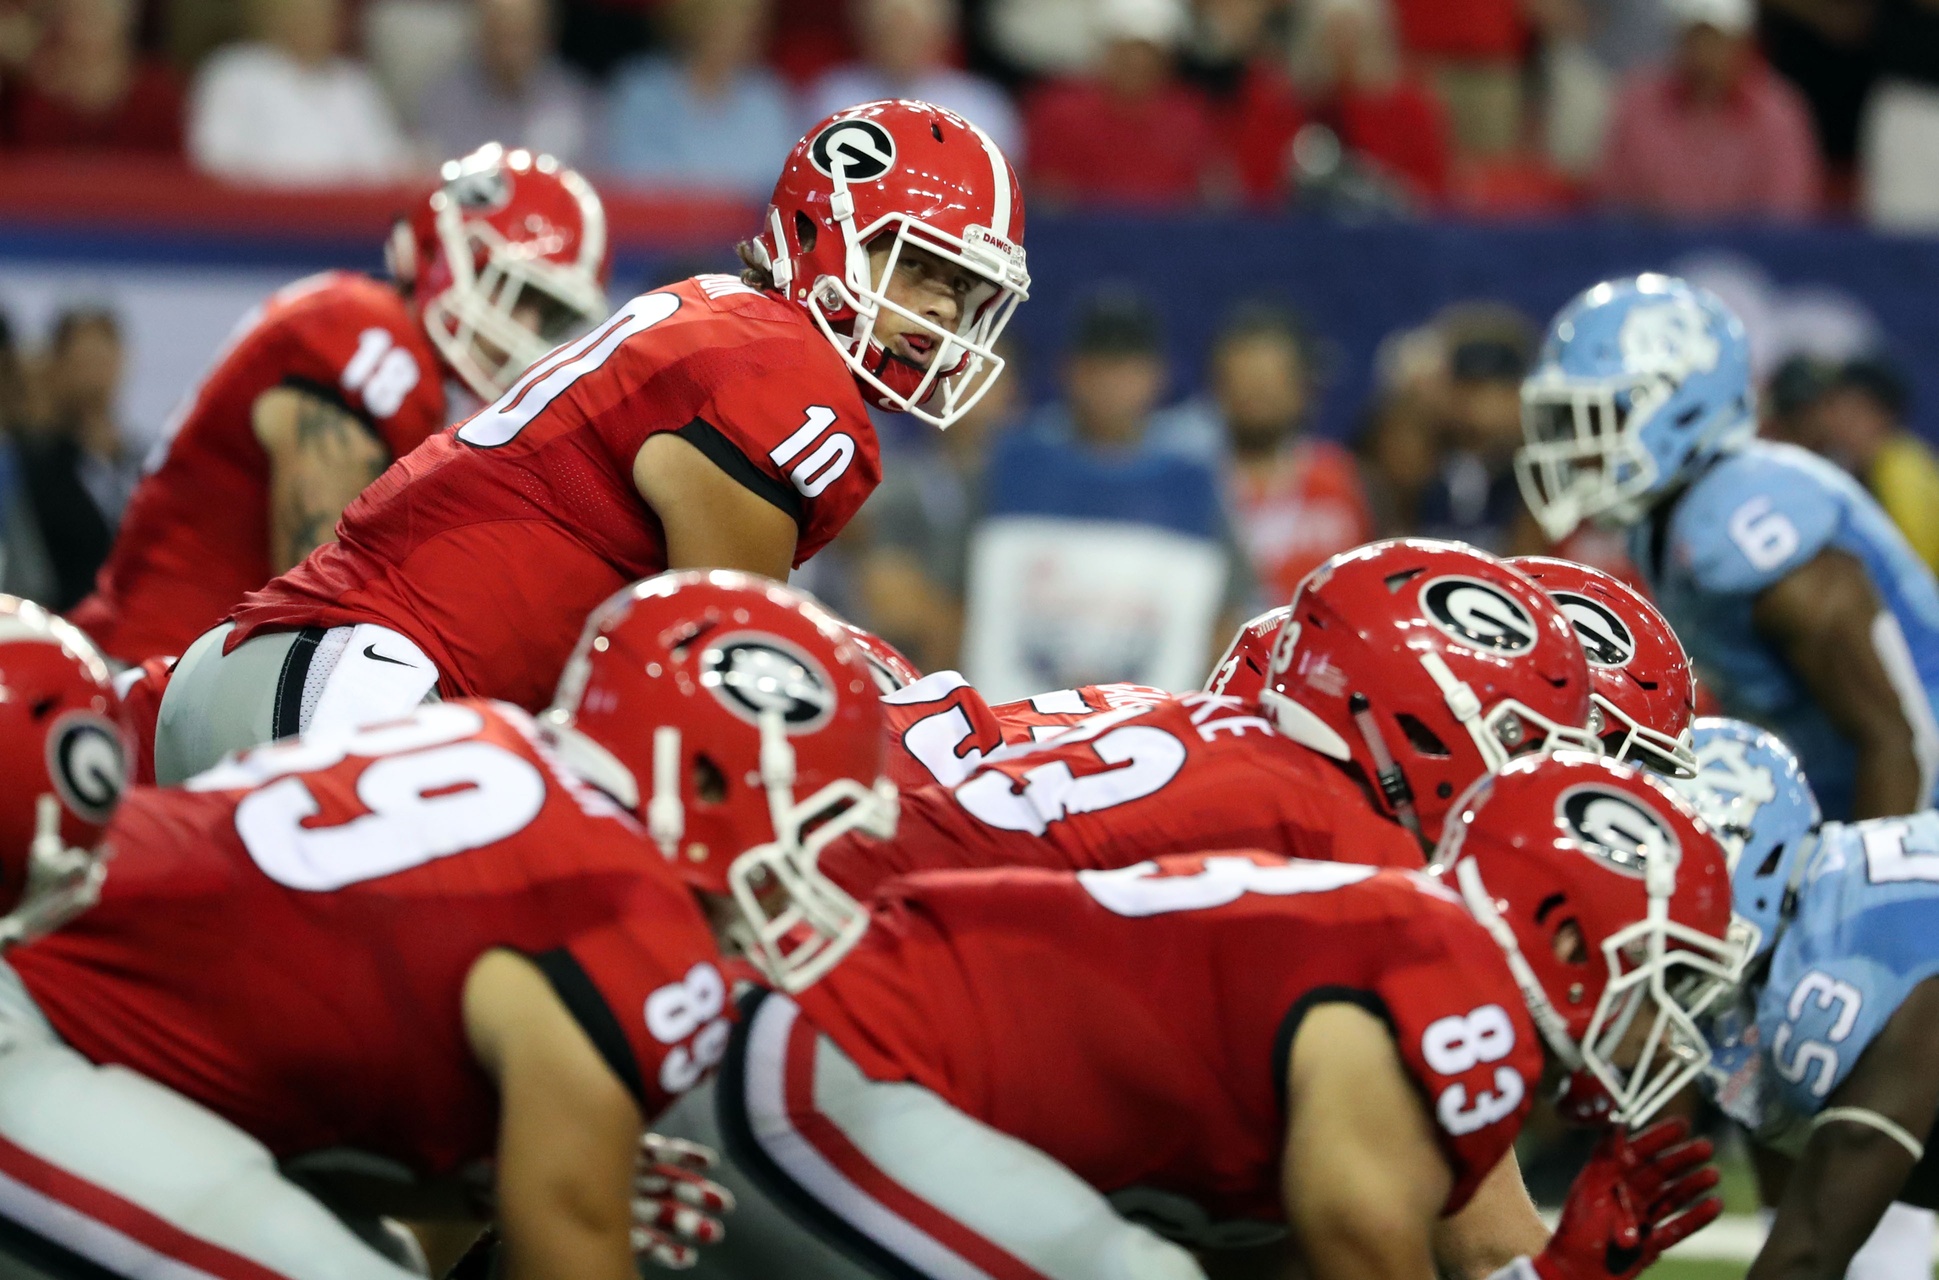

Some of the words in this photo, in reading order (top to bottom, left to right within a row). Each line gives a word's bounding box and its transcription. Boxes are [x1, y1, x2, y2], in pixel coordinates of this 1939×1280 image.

[811, 118, 894, 181] G
[982, 232, 1012, 255] DAWGS
[340, 326, 421, 418] 18
[767, 404, 857, 499] 10
[1729, 496, 1798, 571] 6
[1424, 579, 1534, 652] G
[644, 961, 732, 1093] 89
[1421, 1002, 1525, 1137] 83
[1773, 967, 1863, 1099] 53
